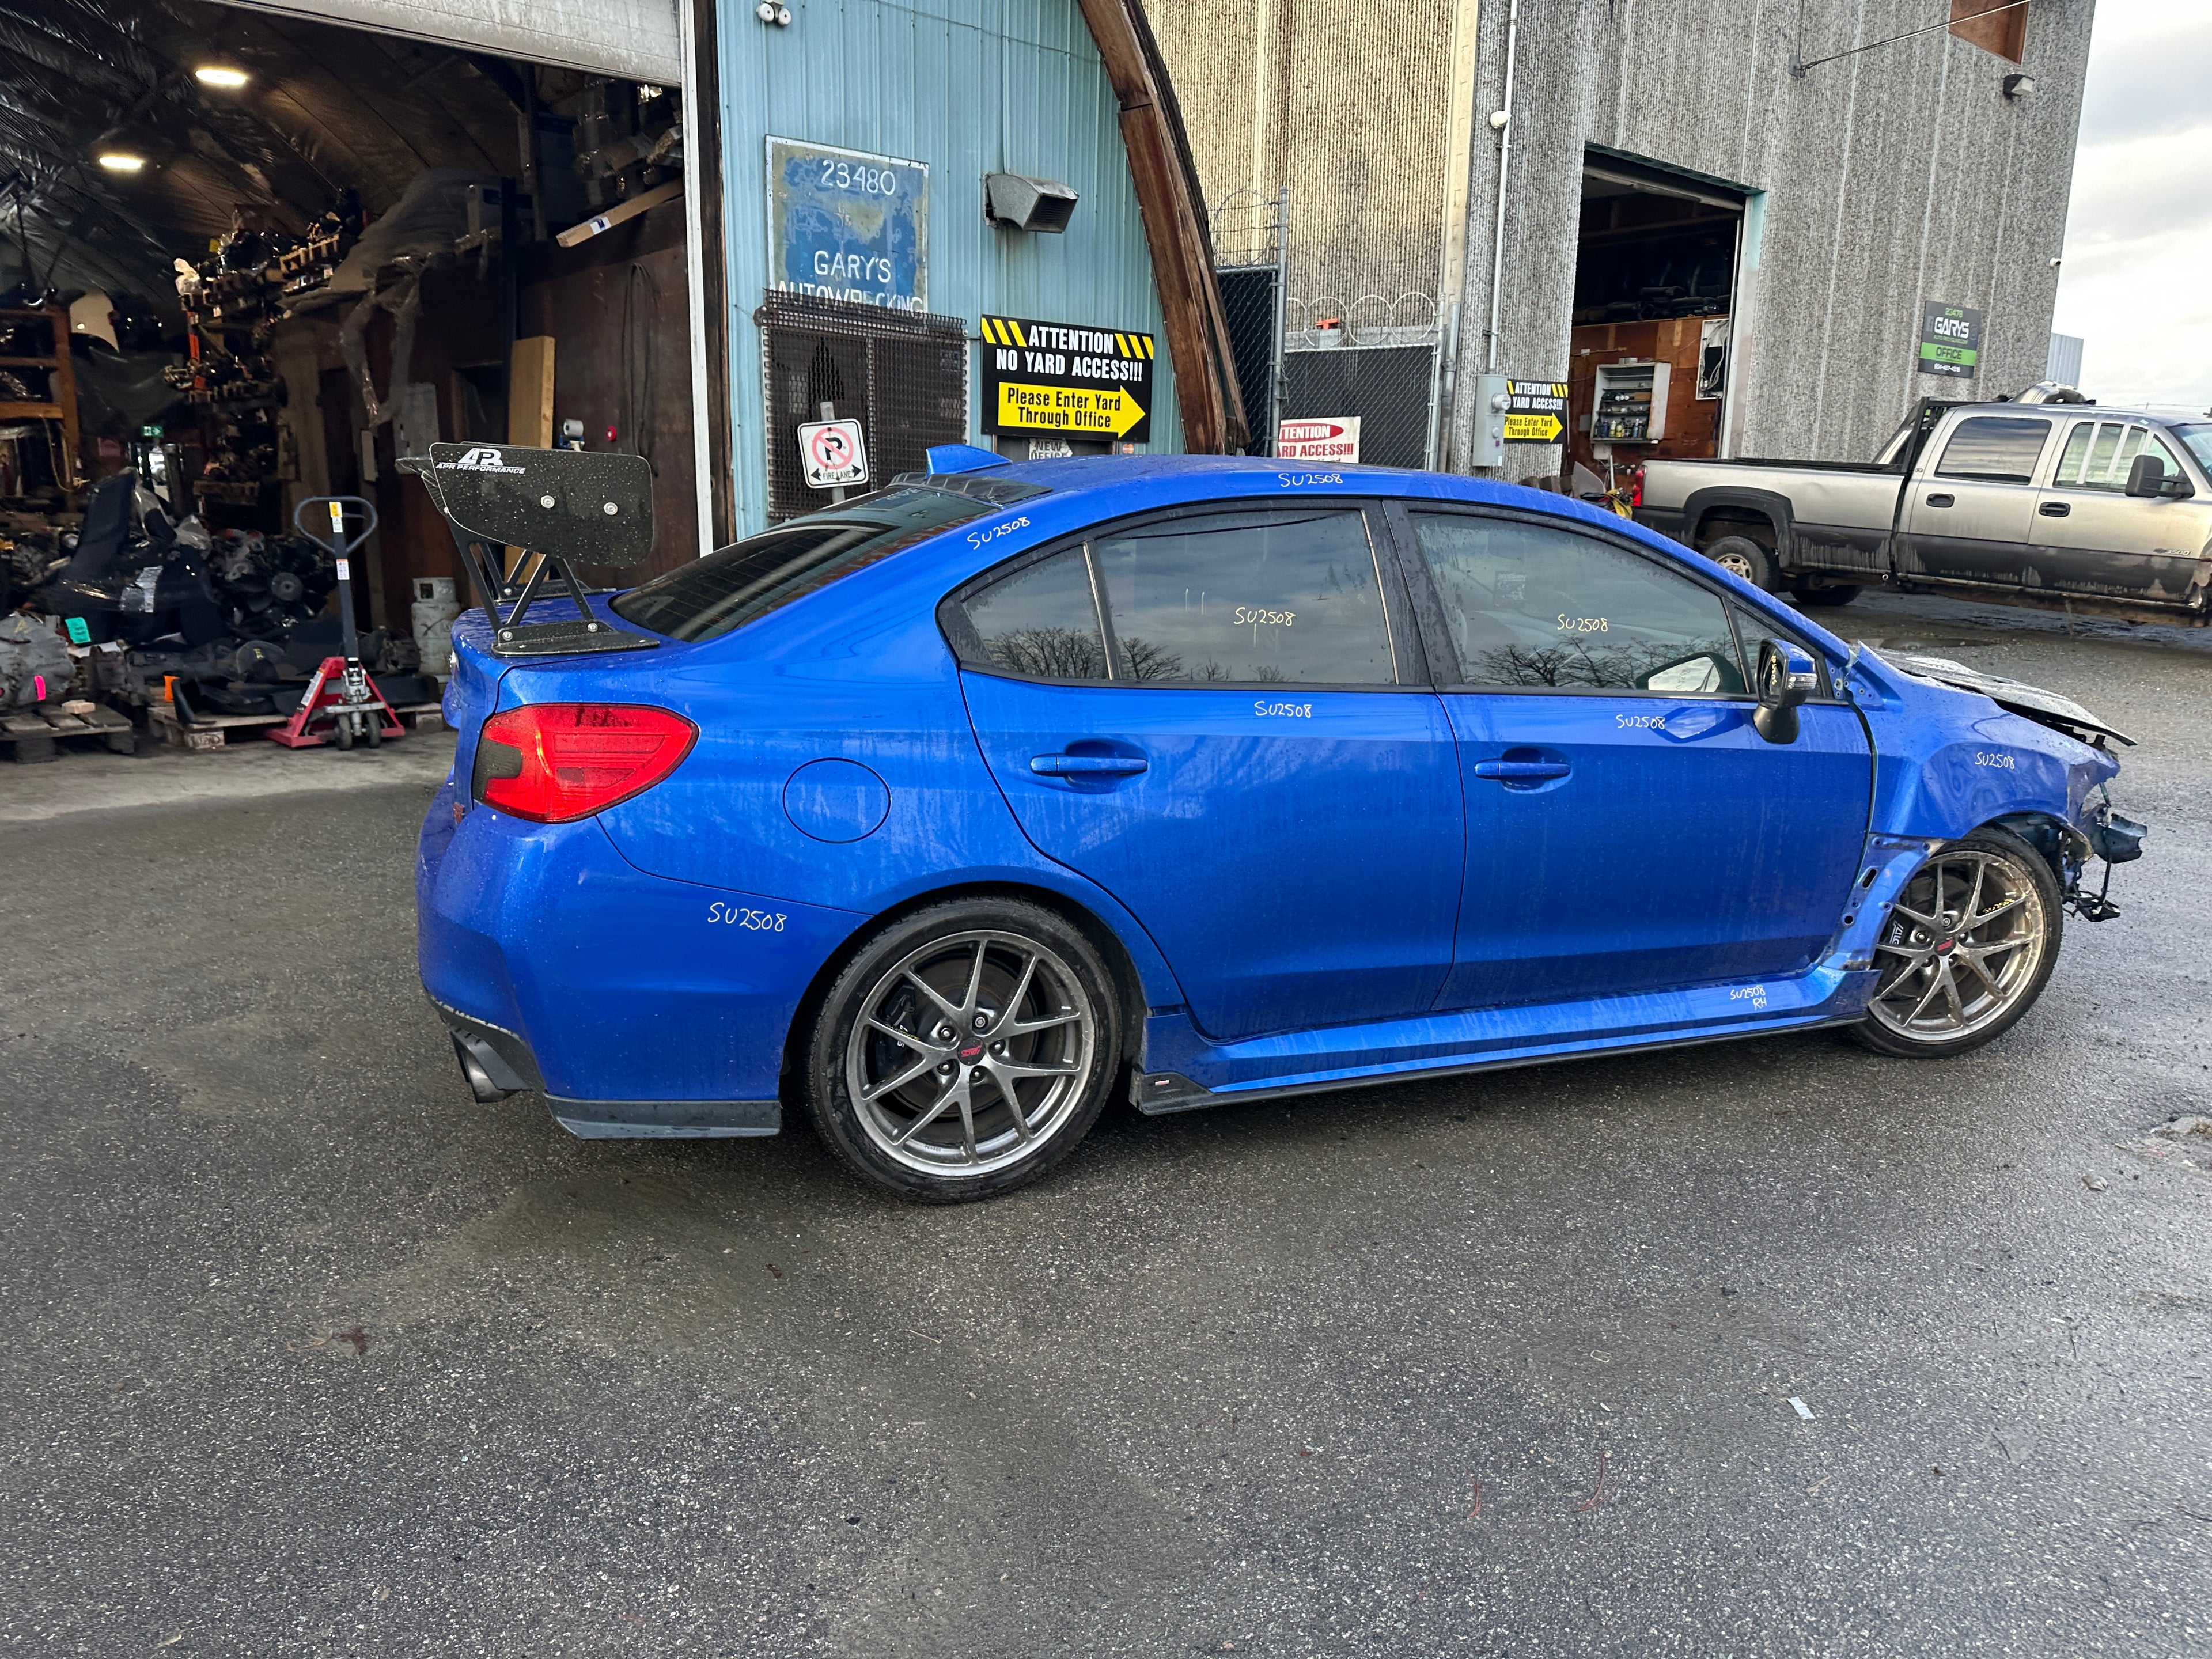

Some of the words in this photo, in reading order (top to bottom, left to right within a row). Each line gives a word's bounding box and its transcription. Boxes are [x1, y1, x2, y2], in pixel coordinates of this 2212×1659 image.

[821, 160, 896, 195] 23480
[814, 250, 891, 283] GARY'S
[1934, 317, 1970, 339] GARYS
[1028, 325, 1114, 354] ATTENTION
[1936, 347, 1963, 360] OFFICE
[996, 349, 1018, 371] NO
[1025, 351, 1065, 375] YARD
[1071, 356, 1142, 382] ACCESS!!!
[1514, 382, 1551, 396] ATTENTION
[1007, 387, 1050, 406] Please
[1056, 391, 1089, 409] Enter
[1095, 394, 1121, 411] Yard
[1513, 396, 1530, 408] YARD
[1532, 397, 1563, 410] ACCESS!!!
[1018, 406, 1069, 427] Through
[1075, 410, 1111, 427] Office
[1505, 416, 1522, 426] Please
[1524, 417, 1539, 426] Enter
[1541, 418, 1552, 427] Yard
[1509, 427, 1530, 437] Through
[1532, 427, 1548, 437] Office
[1037, 440, 1062, 452] NEW
[1300, 443, 1354, 457] ACCESS!!!
[456, 465, 526, 474] PERFORMANCE
[823, 472, 836, 480] FIRE
[1278, 473, 1343, 487] SU2508
[967, 517, 1031, 550] SU2508
[1233, 607, 1296, 626] SU2508
[1557, 613, 1608, 632] SU2508
[1254, 700, 1312, 718] SU2508
[1616, 714, 1665, 729] SU2508
[1975, 752, 2014, 770] SU2508
[707, 902, 788, 932] SU2508
[1730, 984, 1766, 1001] SU2508
[1752, 997, 1767, 1011] RH
